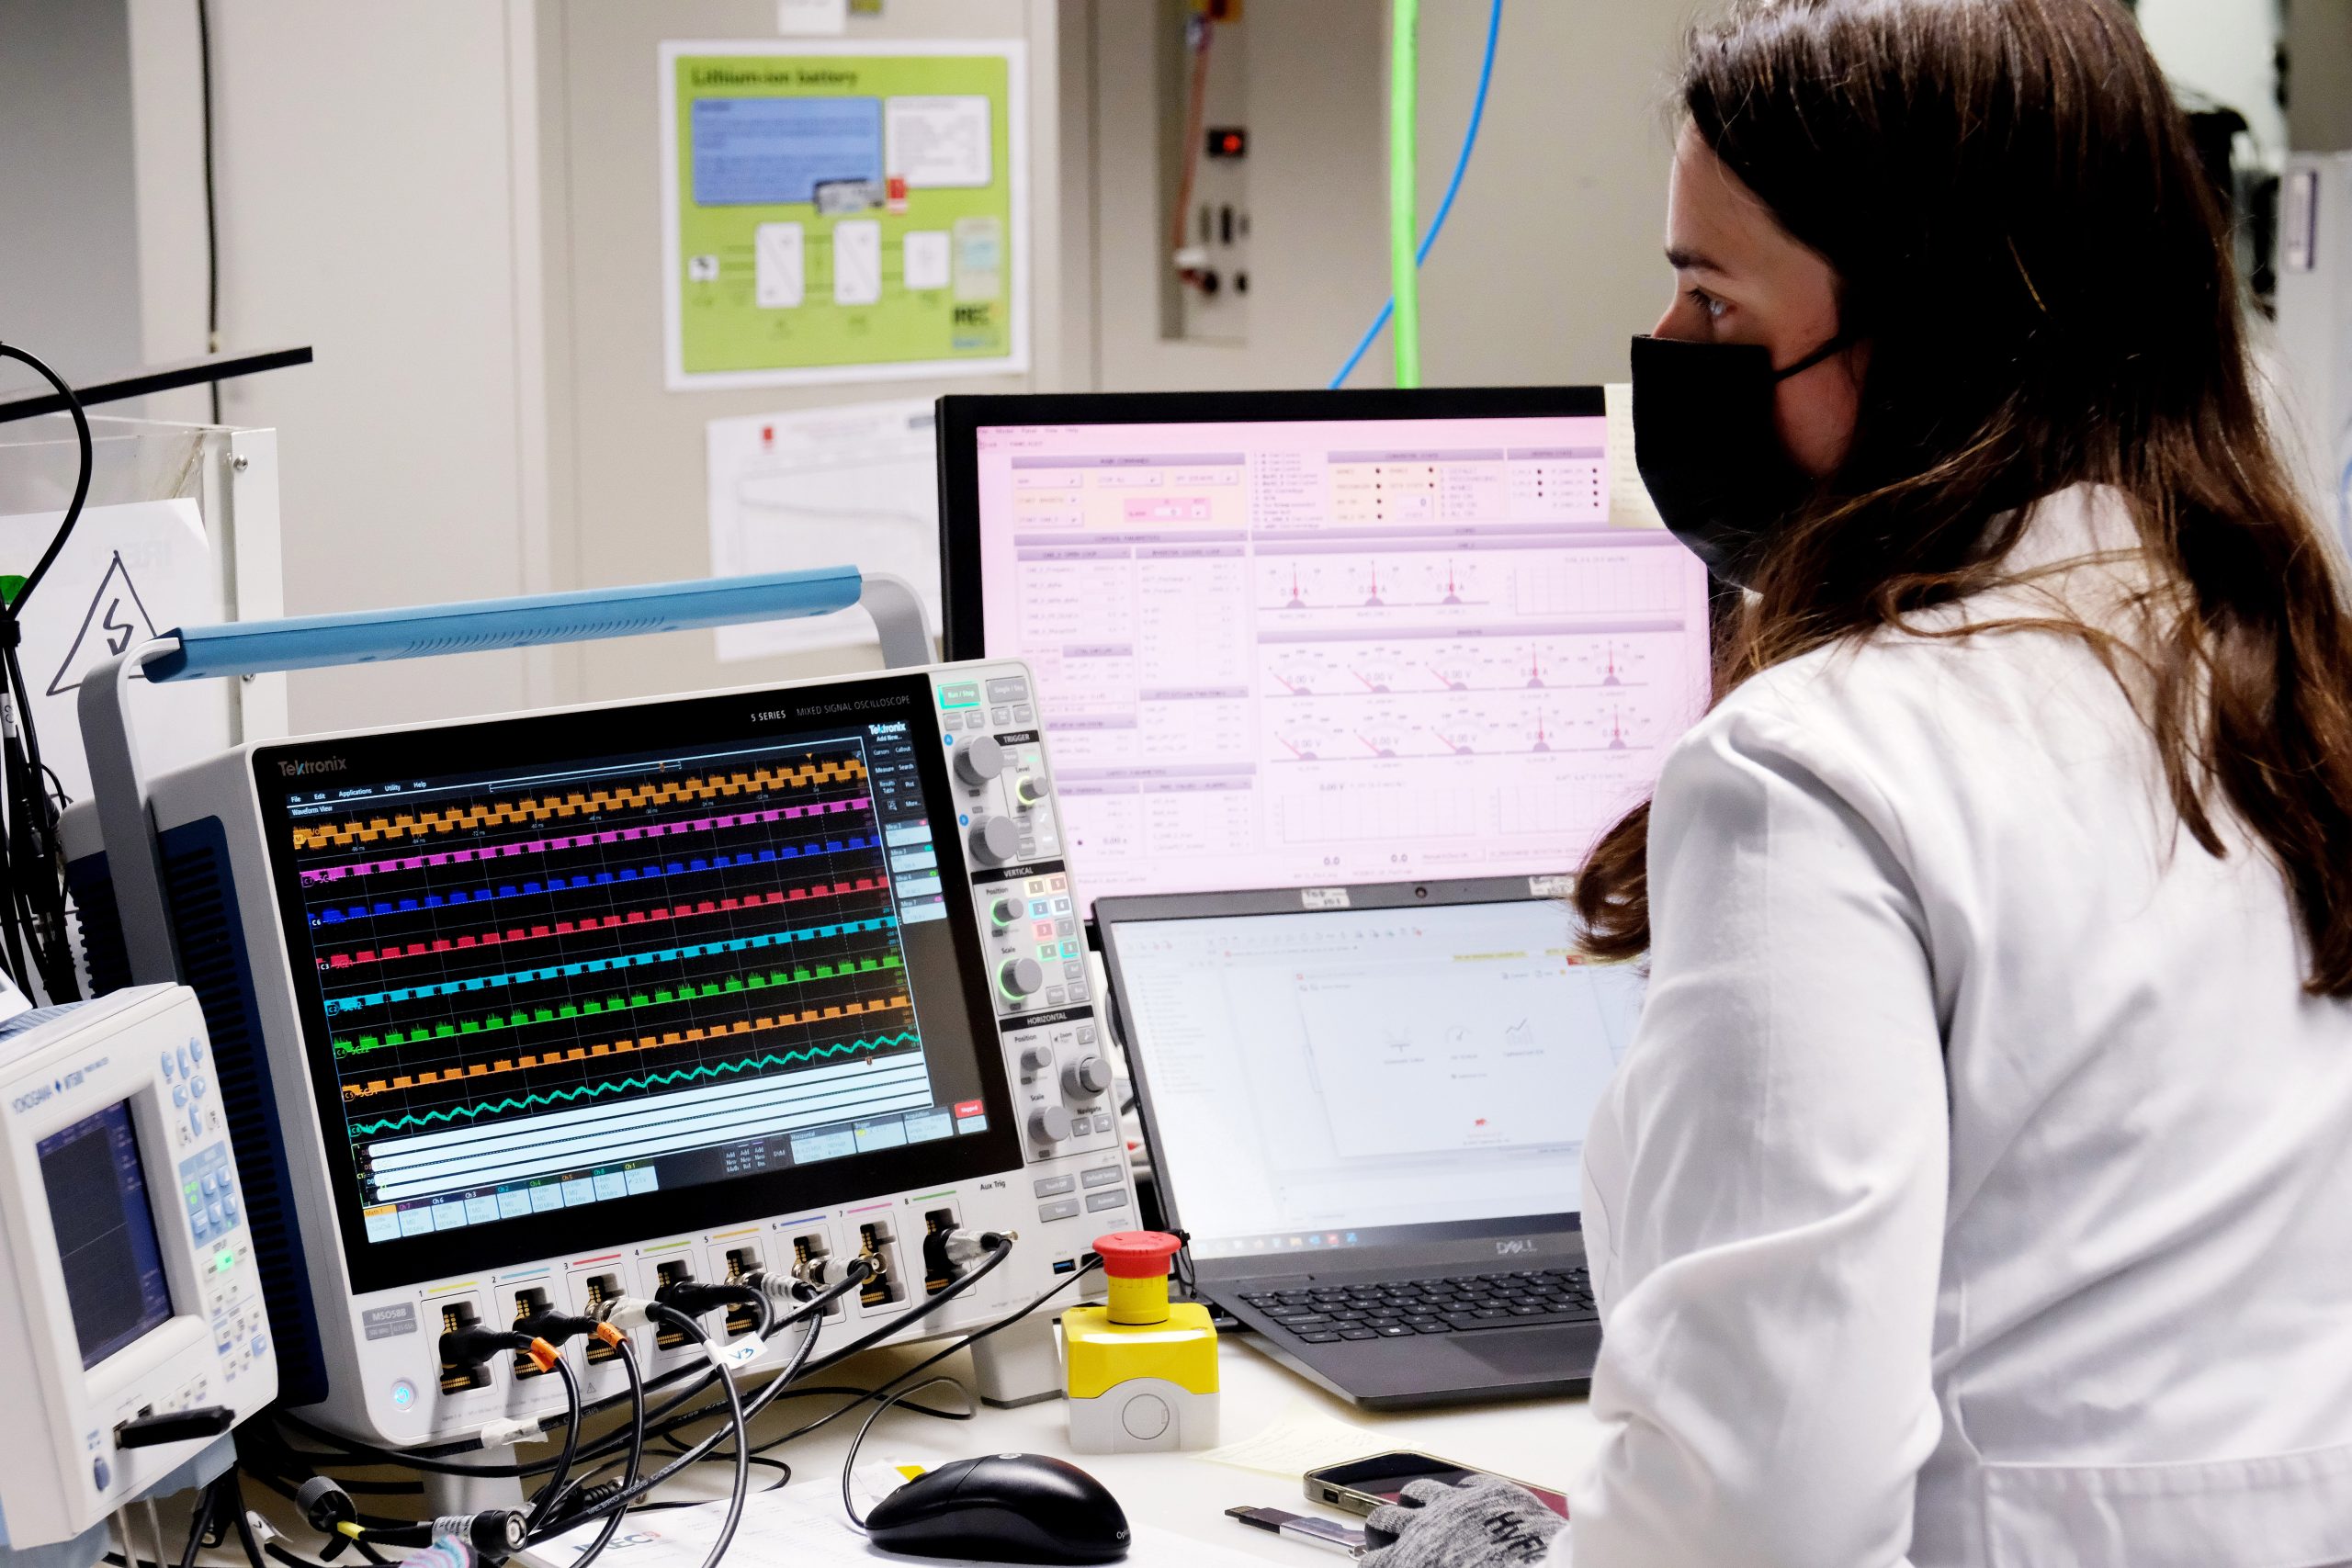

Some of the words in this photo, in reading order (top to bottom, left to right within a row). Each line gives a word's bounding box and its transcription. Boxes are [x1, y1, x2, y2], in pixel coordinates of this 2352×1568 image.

[797, 705, 822, 716] MIXED
[824, 703, 853, 714] SIGNAL
[854, 695, 910, 710] OSCILLOSCOPE
[751, 713, 756, 722] 5
[758, 710, 786, 721] SERIES
[867, 721, 907, 735] Tektronix
[1003, 734, 1030, 743] TRIGGER
[277, 755, 347, 777] Tektronix
[384, 784, 401, 793] Utility
[413, 781, 427, 789] Help
[338, 787, 372, 798] Applications
[291, 807, 319, 817] Waveform
[1003, 866, 1034, 878] VERTICAL
[1001, 946, 1016, 954] Scale
[1026, 1012, 1068, 1026] HORIZONTAL
[1014, 1034, 1036, 1043] Position
[1077, 1105, 1102, 1115] Navigate
[790, 1131, 816, 1141] Horizontal
[979, 1182, 993, 1190] Aux
[993, 1179, 1006, 1189] Trig
[1496, 1239, 1539, 1255] DELL
[372, 1308, 406, 1321] MSO58B
[728, 1348, 754, 1359] V3
